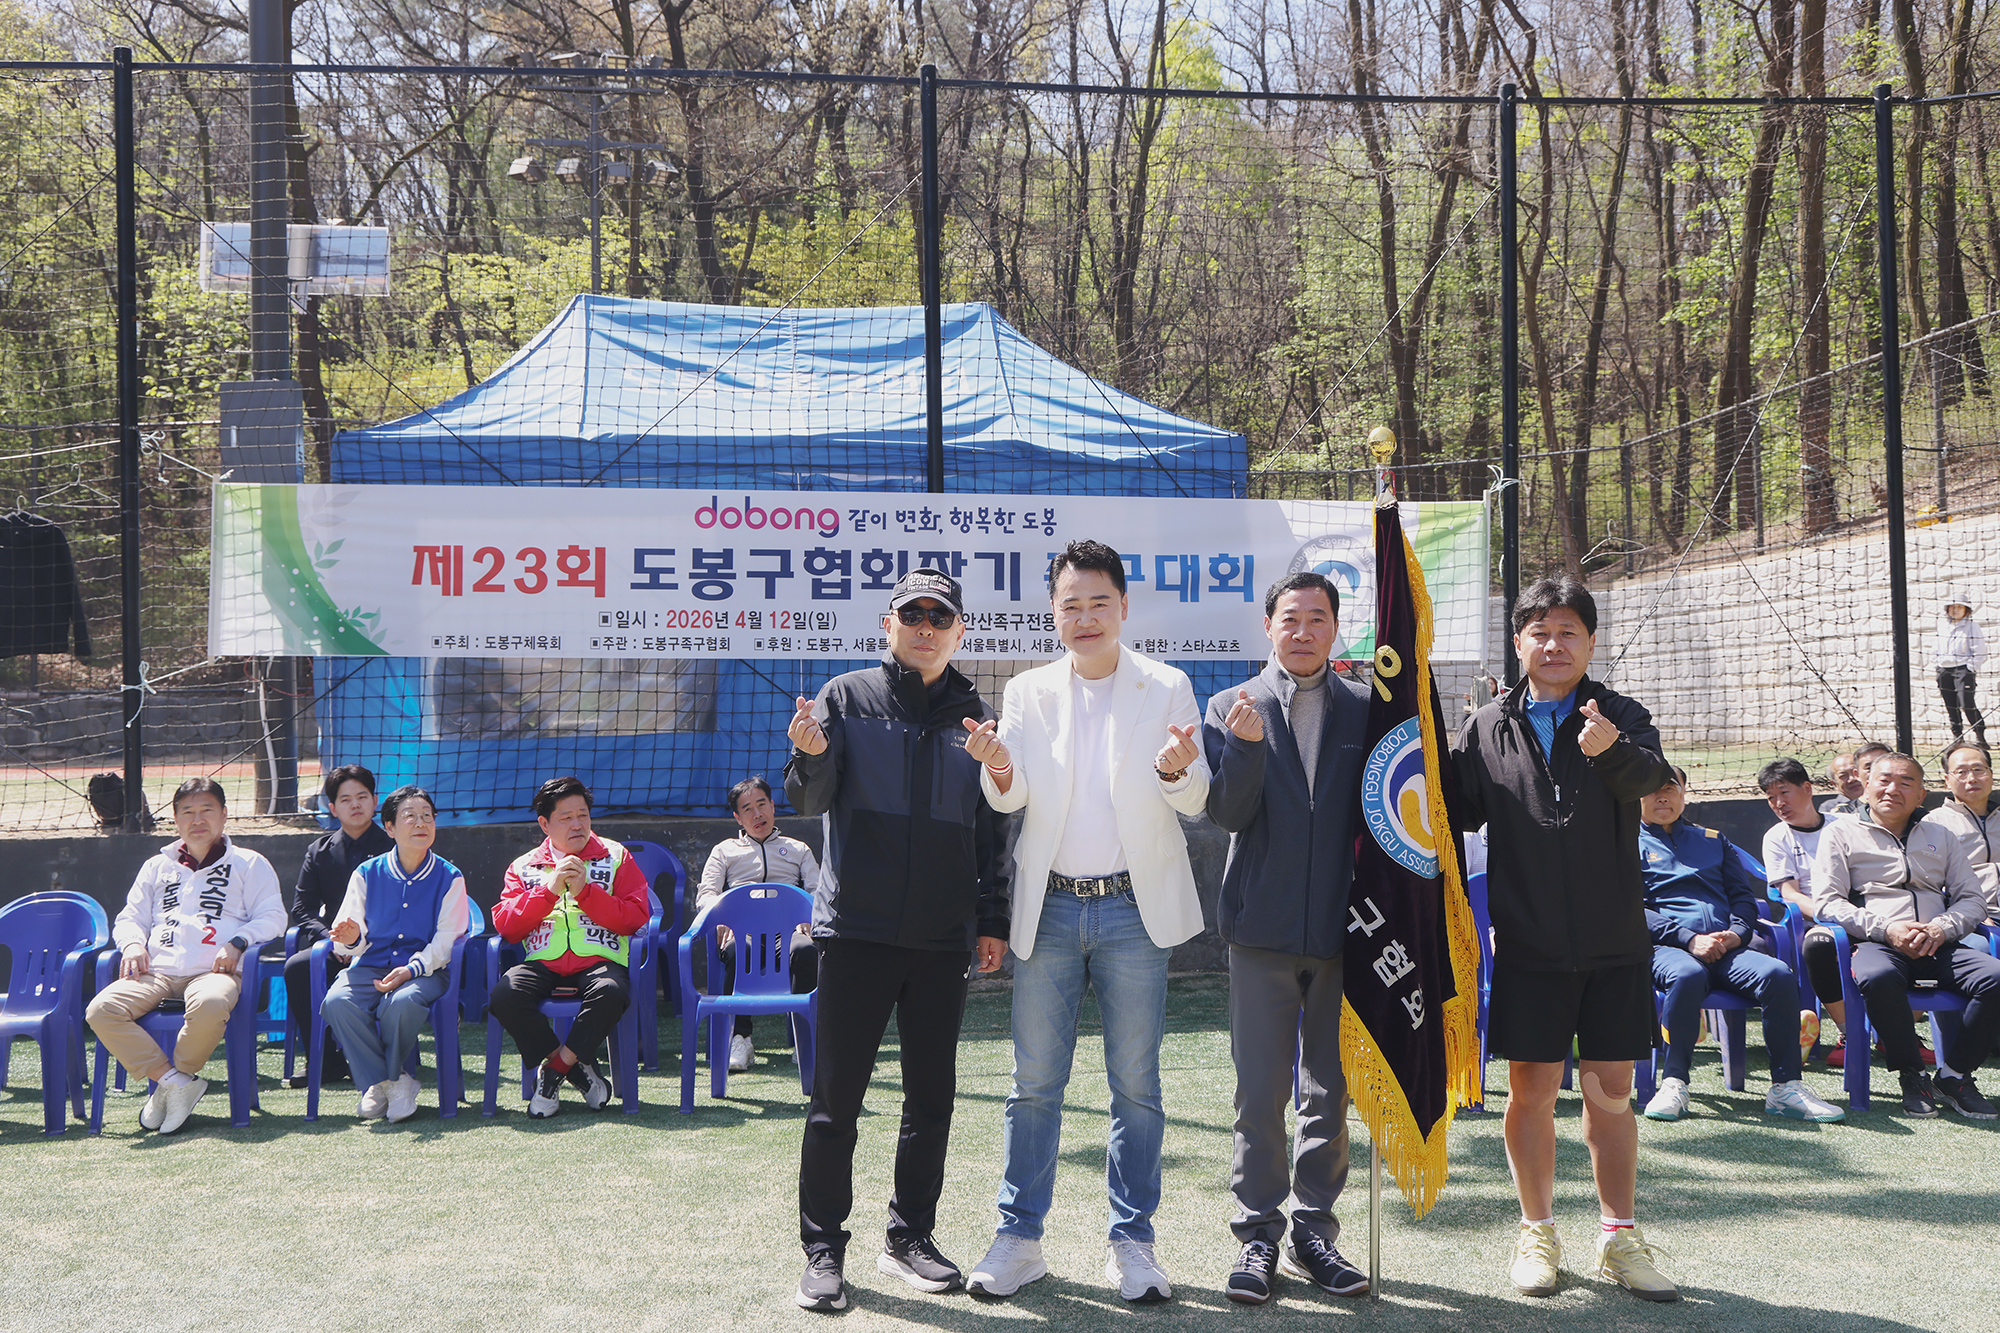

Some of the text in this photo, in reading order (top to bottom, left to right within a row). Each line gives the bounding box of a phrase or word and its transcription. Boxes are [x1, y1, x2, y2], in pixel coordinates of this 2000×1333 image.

[694, 495, 1057, 538] dobong 같이 변화, 행복한 도봉
[1318, 537, 1351, 547] Sports
[411, 545, 606, 598] 제23회
[1043, 552, 1255, 603] 구대회
[907, 573, 950, 586] AMERICAN
[907, 579, 929, 587] ICON
[615, 610, 646, 629] 일시
[666, 609, 729, 629] 2026년
[735, 610, 762, 630] 4월
[769, 610, 837, 631] 12일(일)
[444, 635, 470, 650] 주최
[485, 635, 562, 650] 도봉구체육회
[603, 636, 628, 651] 주관
[642, 636, 730, 651] 도봉구족구협회
[767, 637, 792, 652] 후원
[806, 638, 848, 653] 도봉구,
[961, 638, 1026, 653] 서울특별시,
[1144, 639, 1168, 653] 협찬
[1181, 640, 1241, 653] 스타스포츠
[1365, 727, 1409, 802] DOBONGGU
[1366, 807, 1400, 852] JOKGU
[201, 926, 217, 946] 2
